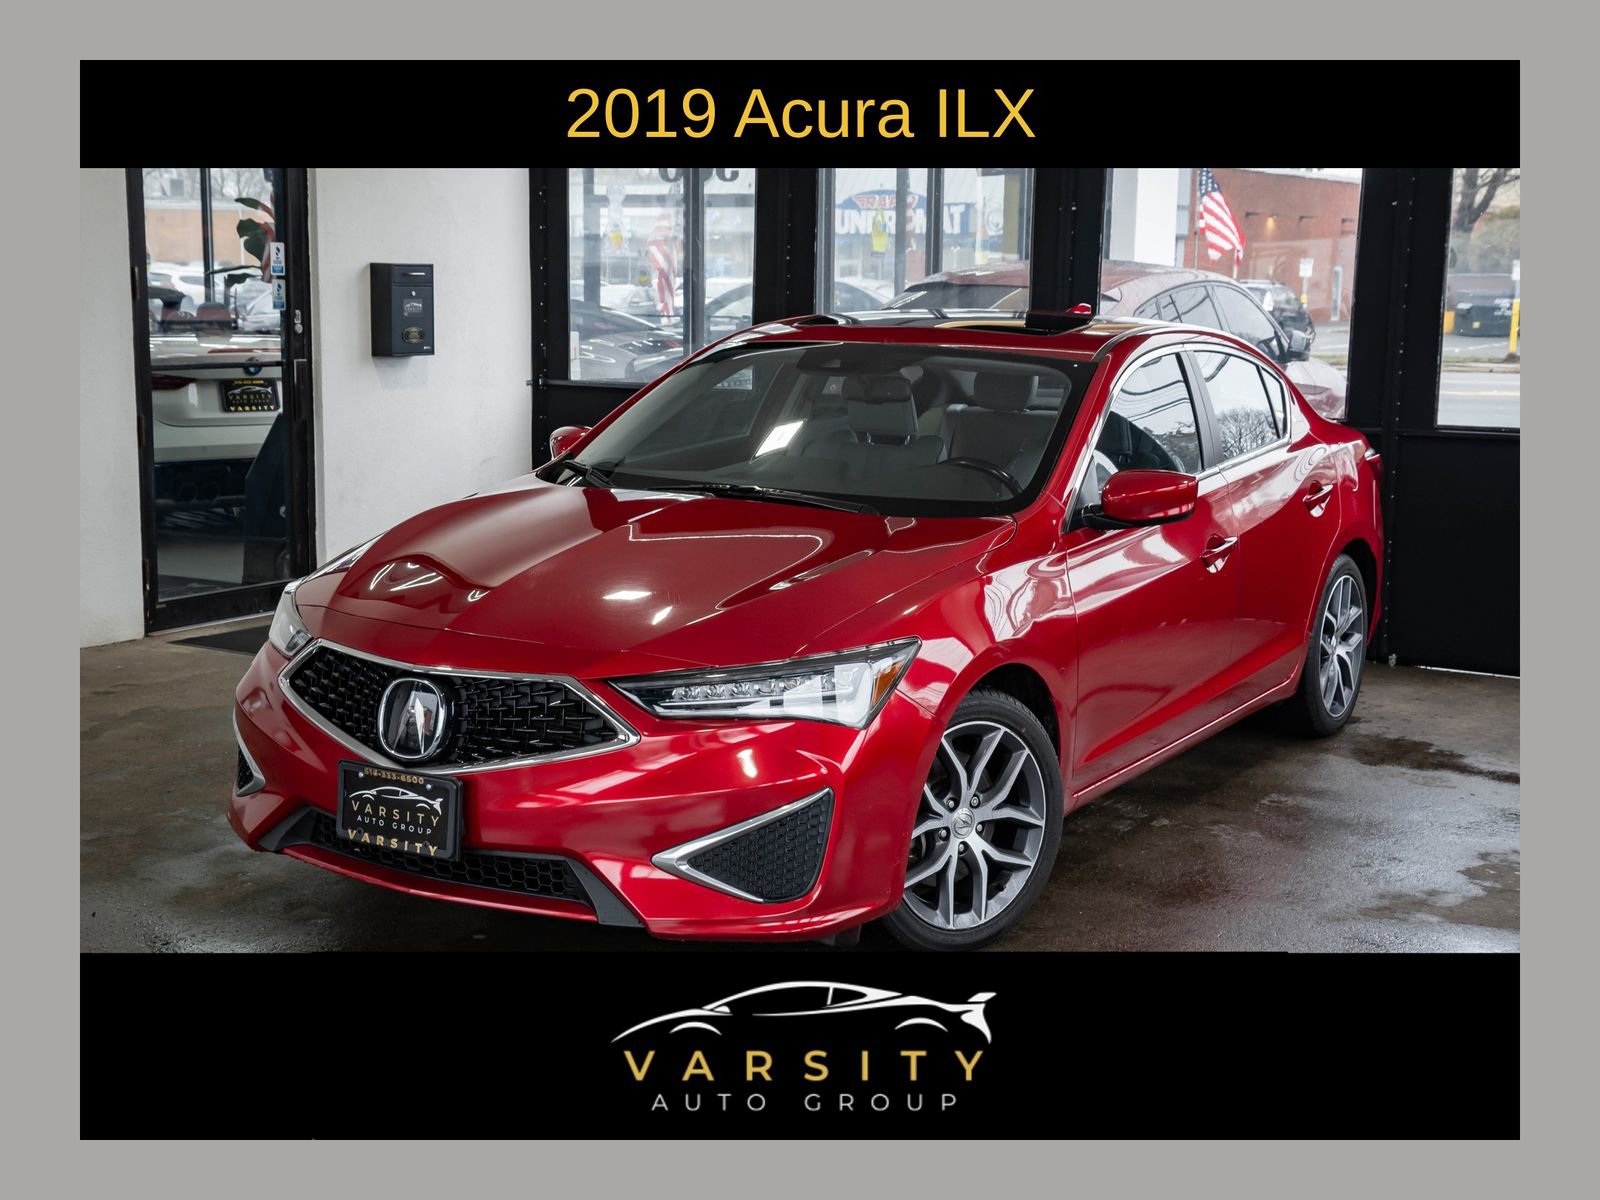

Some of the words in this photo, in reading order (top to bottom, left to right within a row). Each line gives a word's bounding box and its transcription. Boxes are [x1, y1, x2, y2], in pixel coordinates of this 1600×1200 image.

[351, 799, 439, 827] VARSITY
[356, 814, 385, 827] AUTO
[392, 822, 432, 835] GROUP
[347, 828, 438, 857] VARSITY
